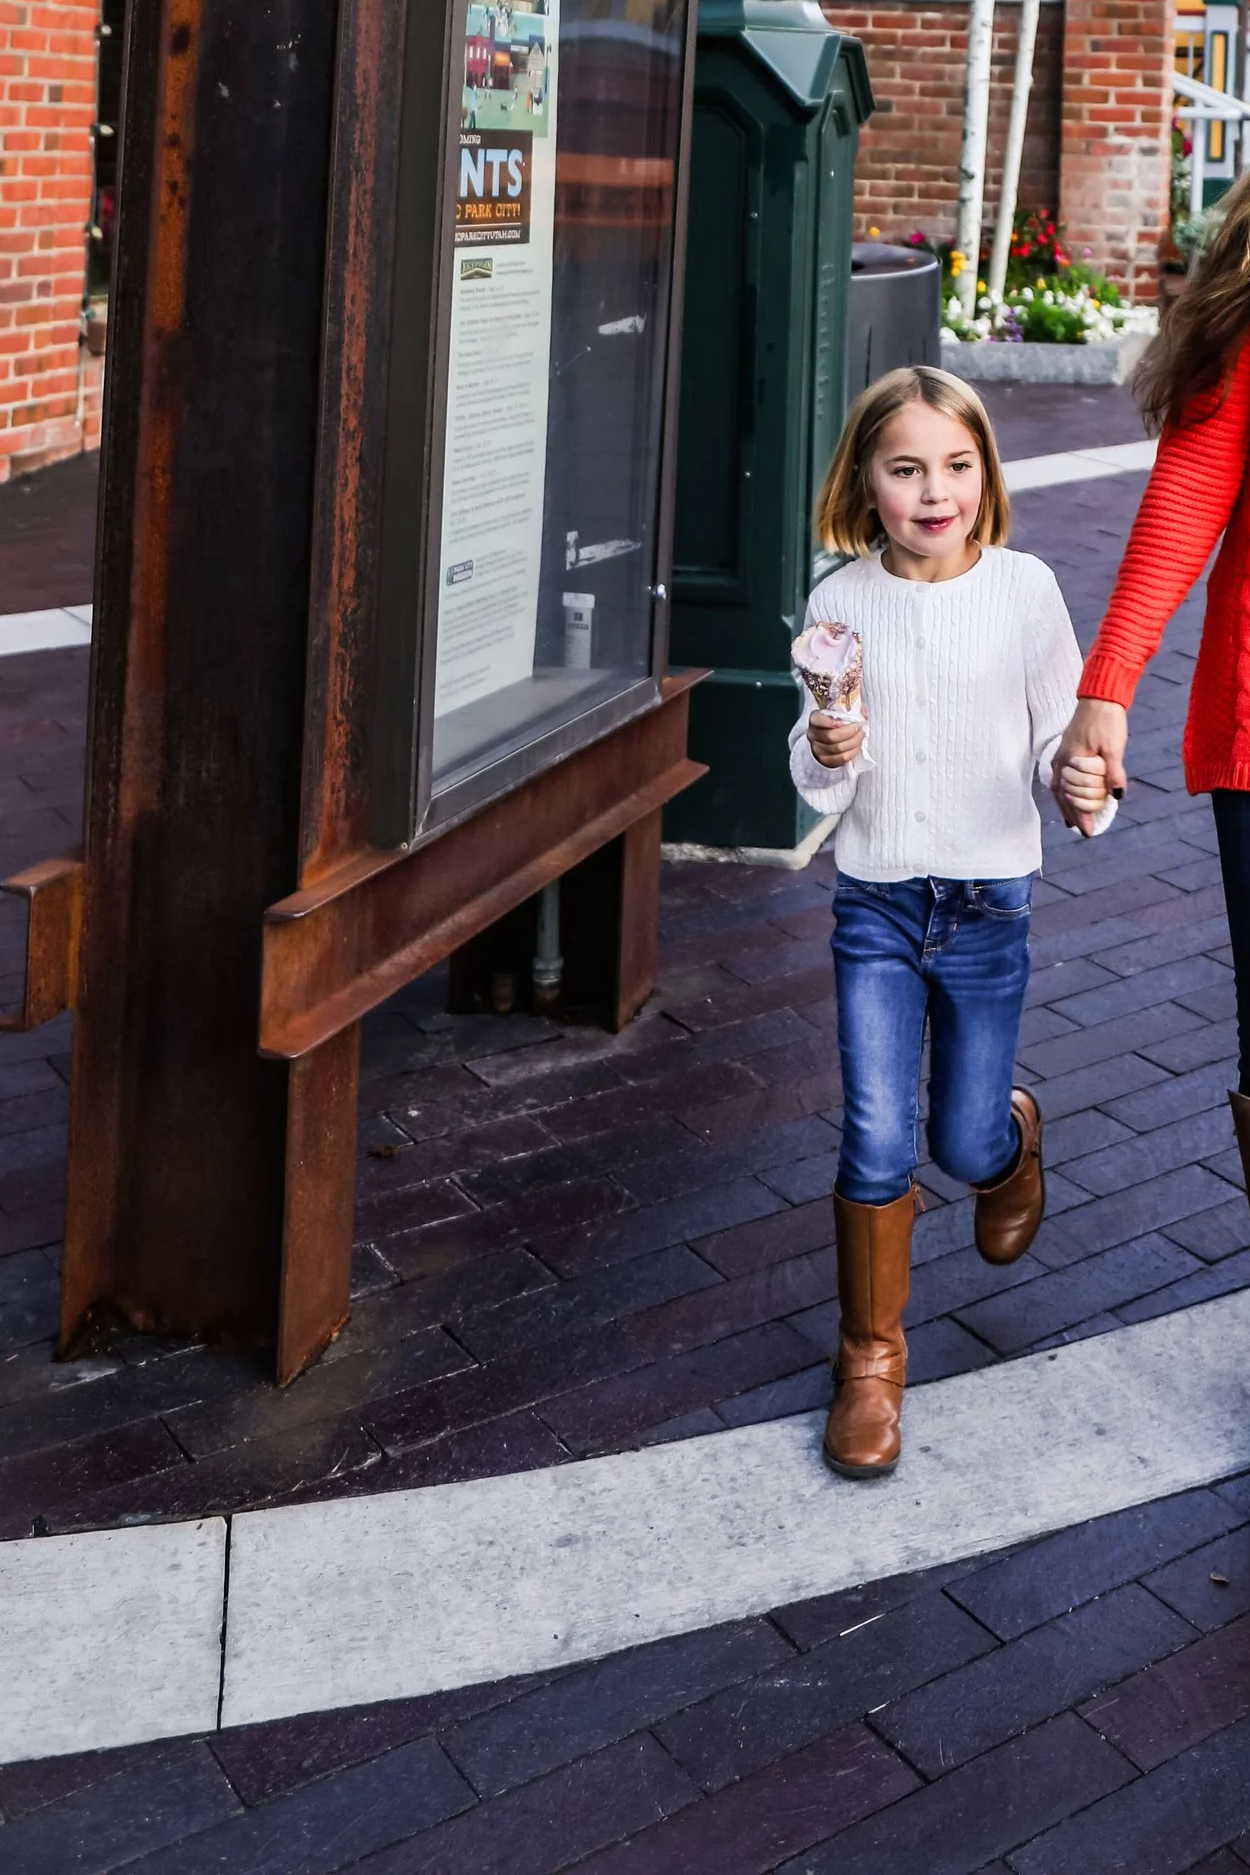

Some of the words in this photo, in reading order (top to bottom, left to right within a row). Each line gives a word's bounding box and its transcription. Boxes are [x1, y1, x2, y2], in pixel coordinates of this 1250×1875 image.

[460, 148, 523, 198] NTS
[465, 203, 492, 219] PARK
[495, 203, 521, 218] CITY!
